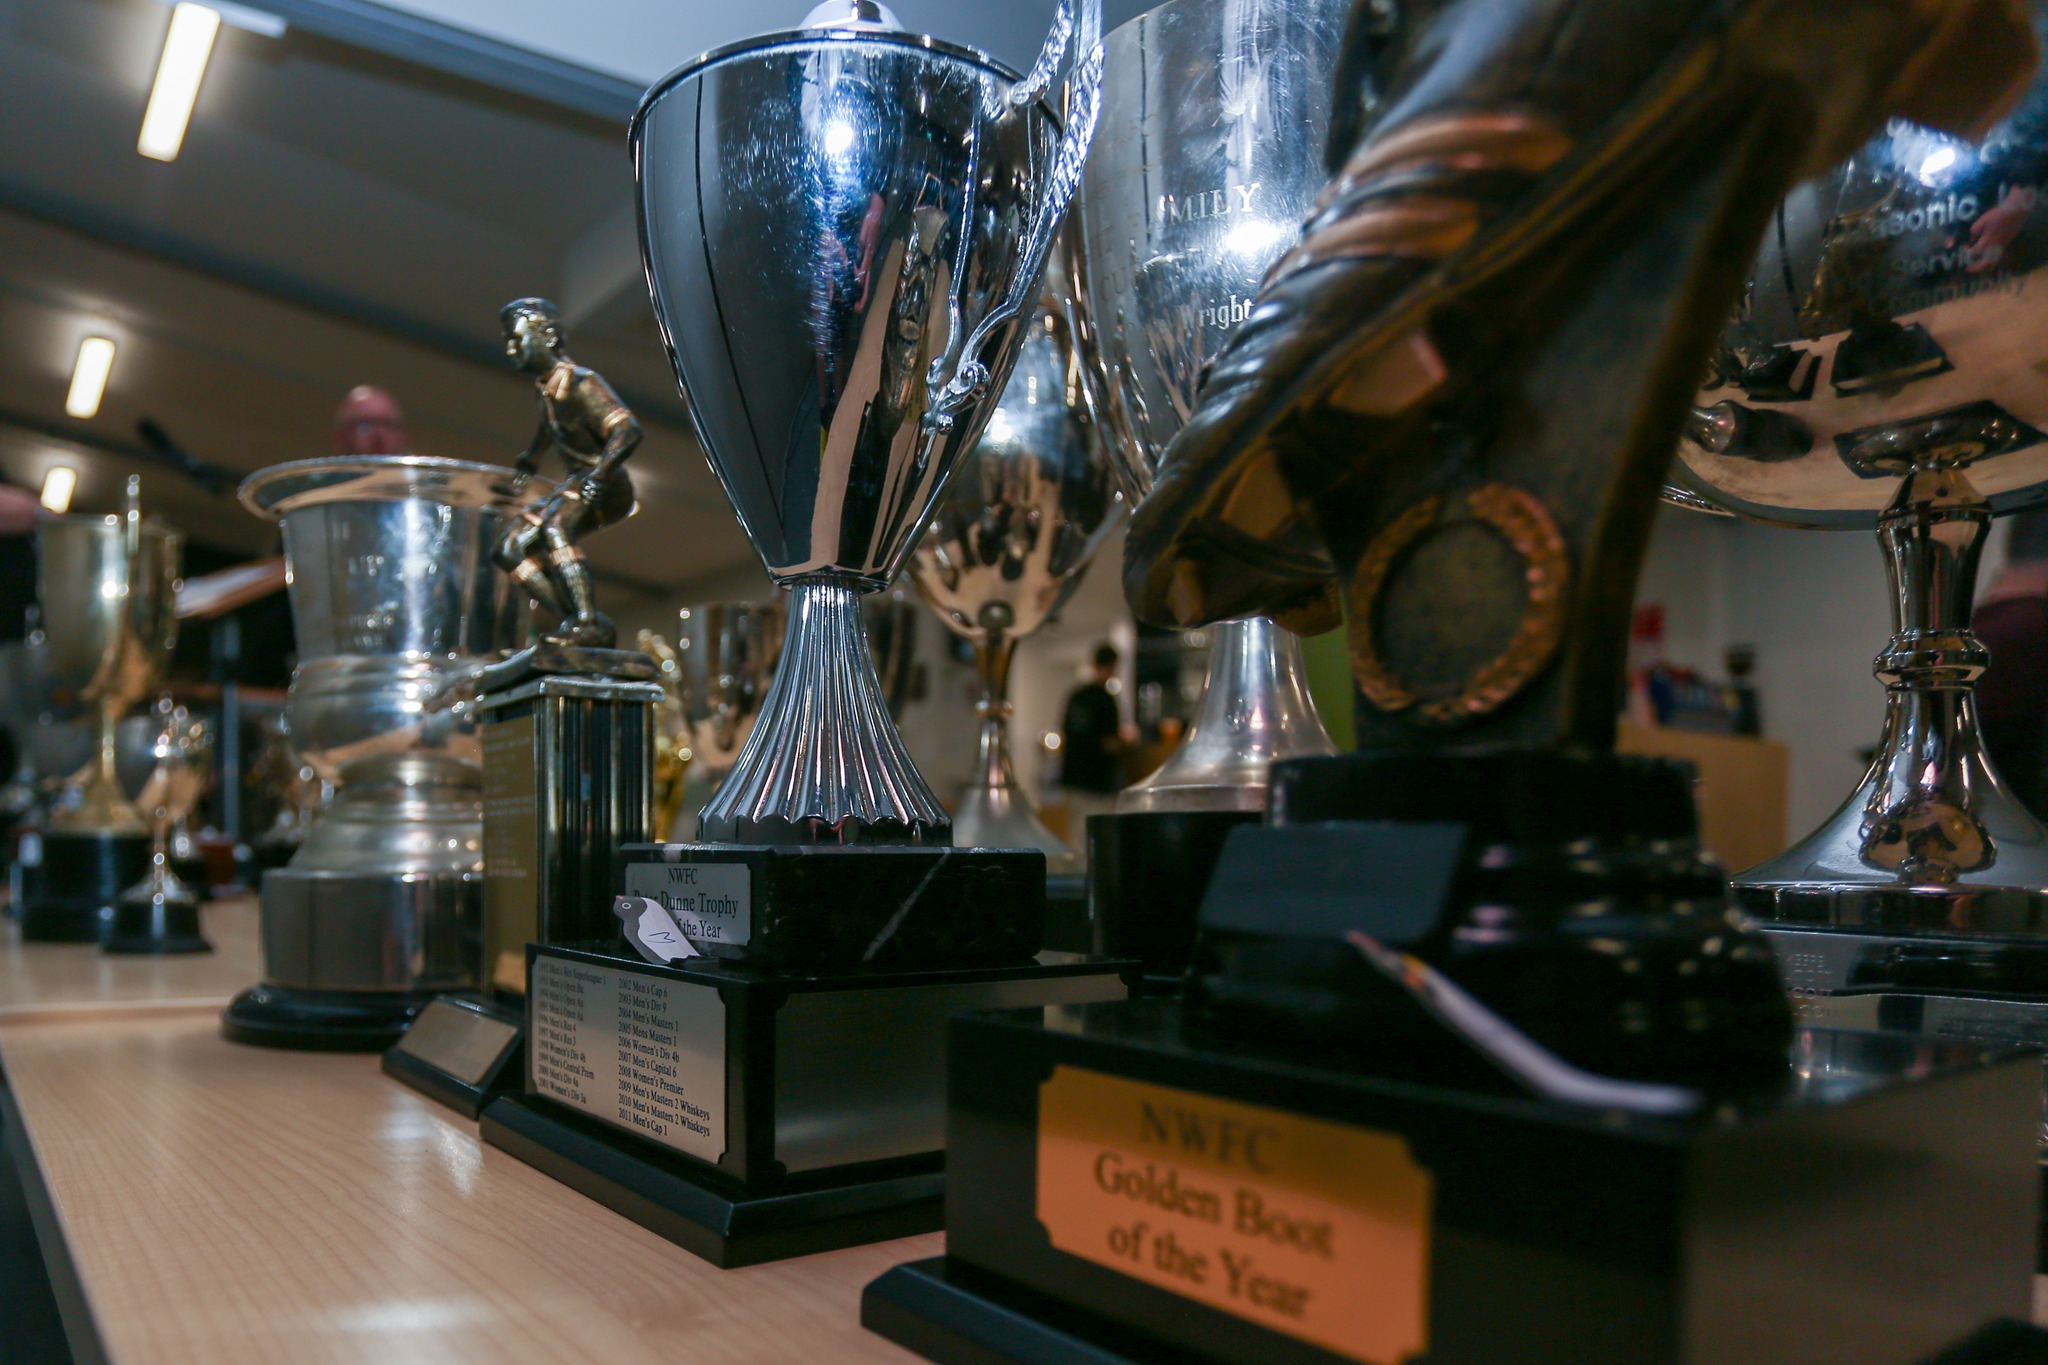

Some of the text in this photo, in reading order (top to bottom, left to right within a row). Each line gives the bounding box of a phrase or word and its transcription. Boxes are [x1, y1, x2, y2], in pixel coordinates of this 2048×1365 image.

[668, 868, 698, 885] NWFC
[661, 891, 695, 912] Dunne
[698, 893, 739, 919] Trophy
[683, 919, 697, 937] the
[699, 920, 721, 938] Year
[618, 978, 668, 999] 2002 Men's Cap 6
[618, 992, 666, 1013] 2003 Men's Div 9
[618, 1007, 678, 1032] 2004 Men's Masters 1
[618, 1021, 677, 1047] 2005 Mens Masters 1
[618, 1036, 679, 1063] 2006 Women's Div 4b
[563, 1061, 580, 1075] Central
[581, 1066, 594, 1080] Prem
[618, 1050, 676, 1078] 2007 Men's Capital 6
[618, 1064, 684, 1096] 2008 Women's Premier
[618, 1079, 710, 1121] 2009 Men's Masters 2 Whiskeys
[618, 1093, 710, 1137] 2010 Men's Masters 2 Whiskeys
[618, 1107, 667, 1136] 2011 Men's Cap 1
[1140, 1101, 1281, 1174] NWFC
[1094, 1149, 1335, 1259] Golden Boot
[1107, 1221, 1313, 1319] of the Year
